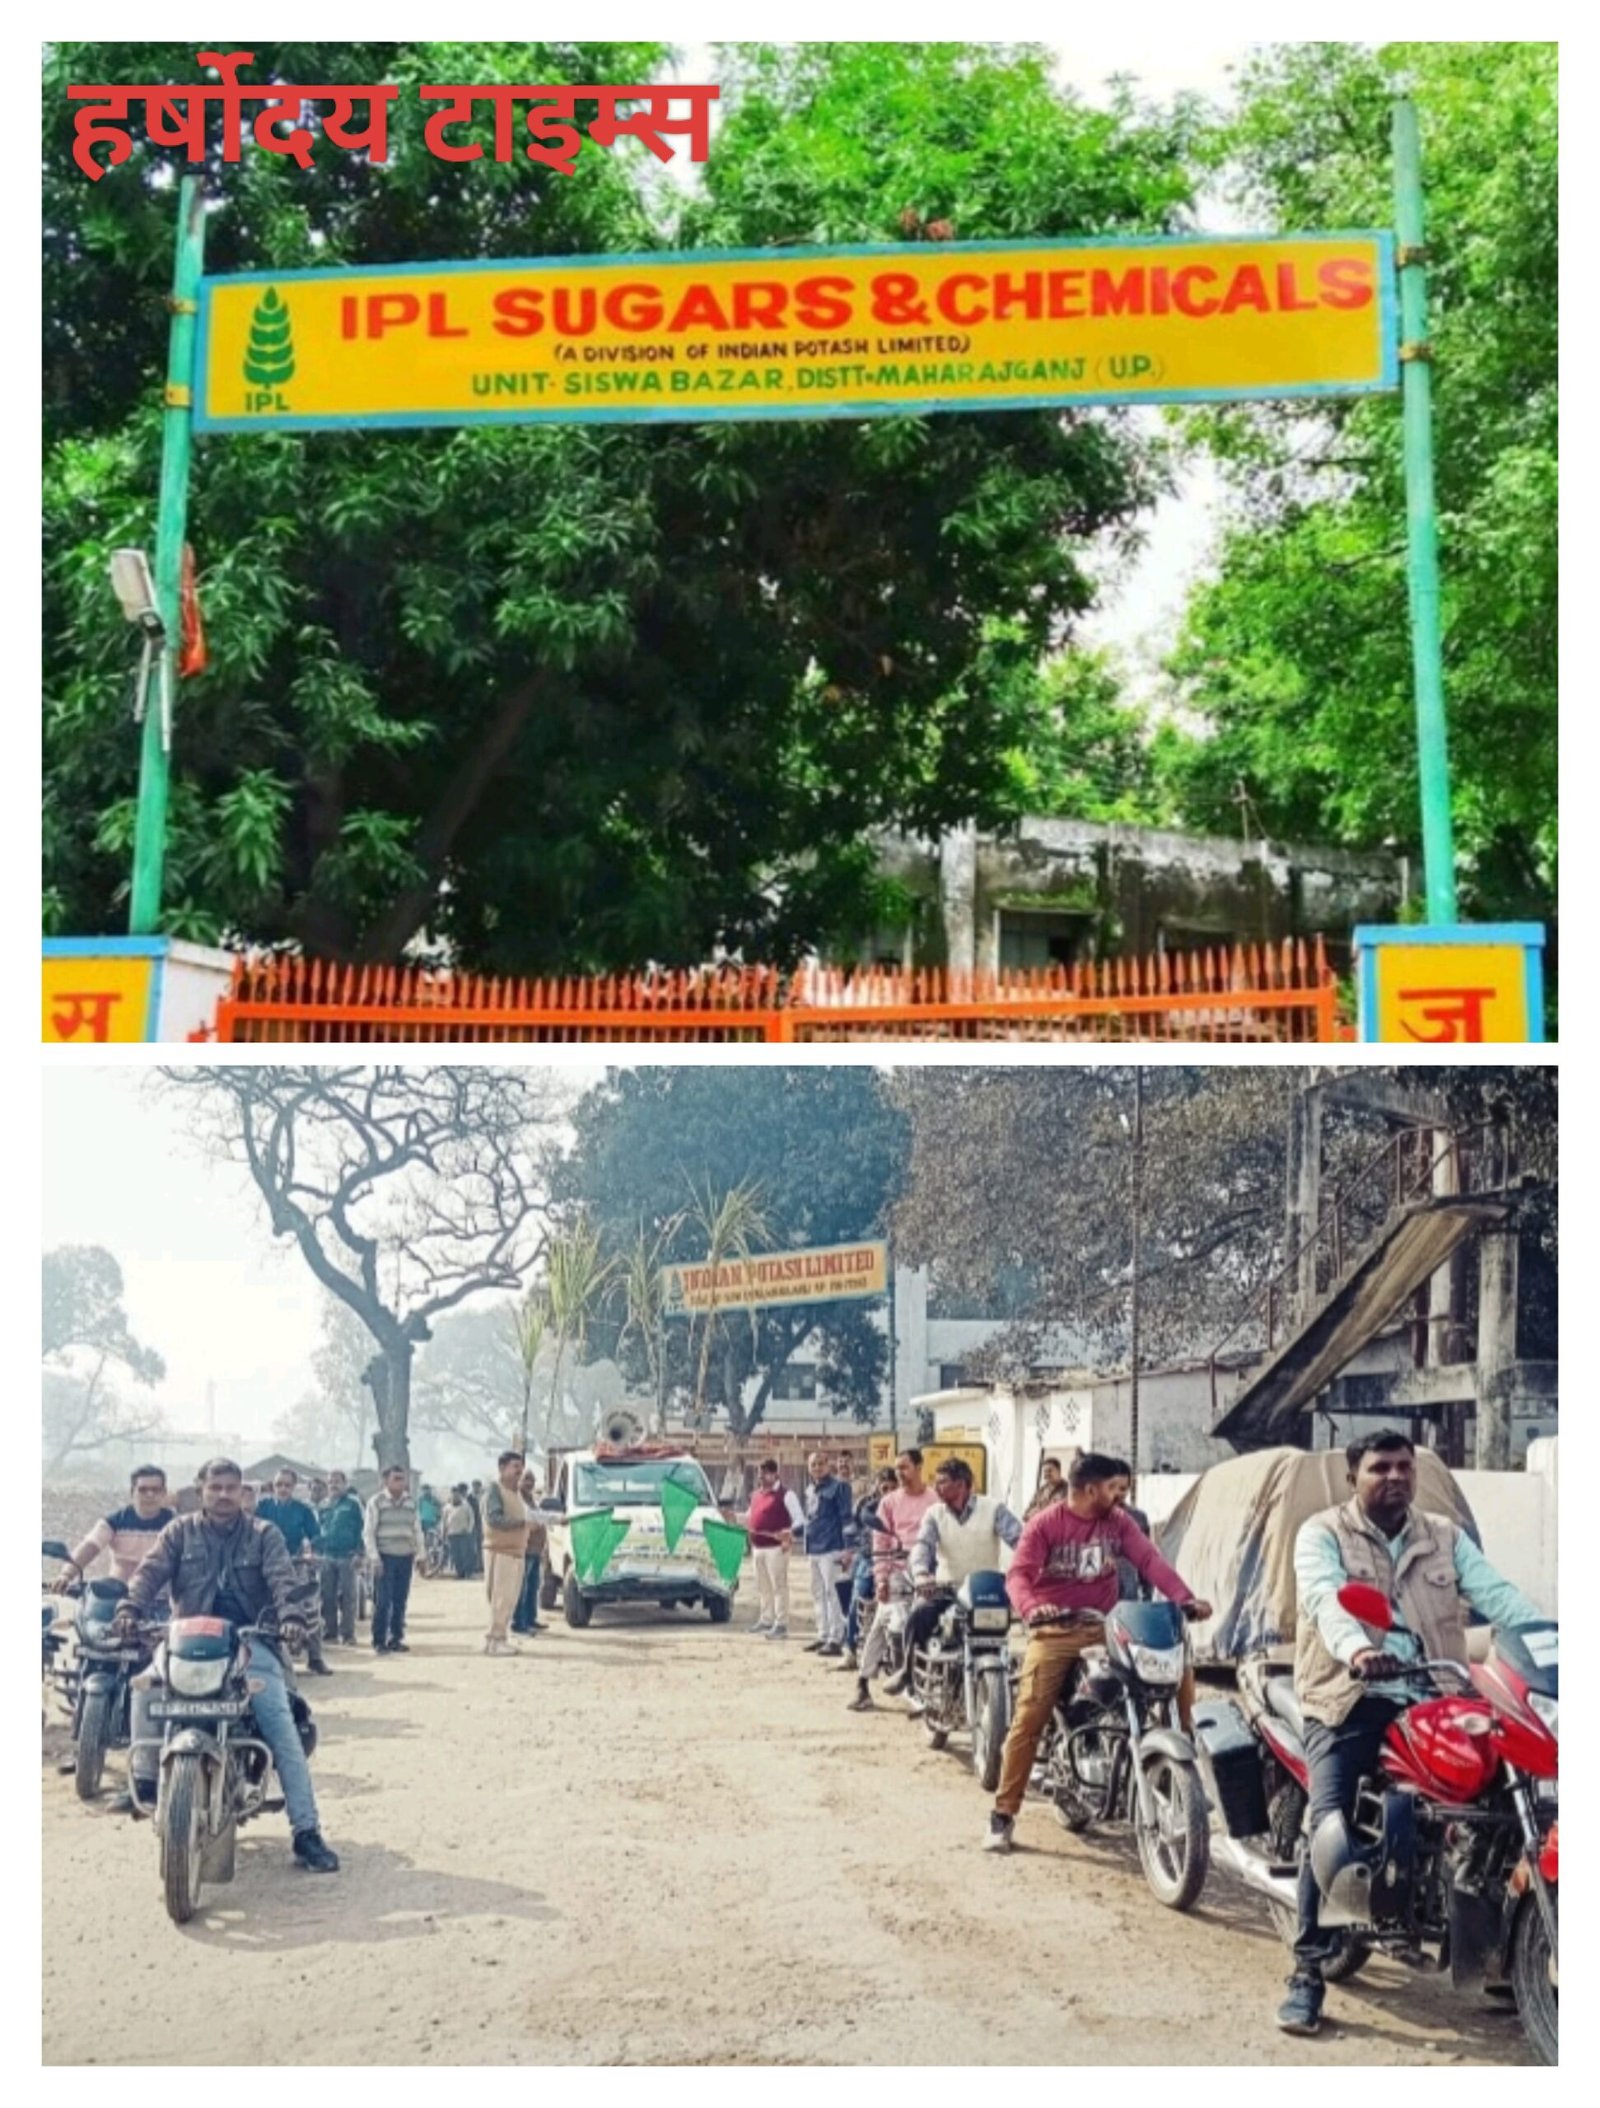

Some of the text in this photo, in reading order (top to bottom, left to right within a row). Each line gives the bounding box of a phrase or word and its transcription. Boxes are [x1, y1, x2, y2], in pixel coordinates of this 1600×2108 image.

[342, 293, 468, 340] IPL
[492, 279, 855, 337] SUGARS
[584, 344, 674, 362] DIVISION
[686, 343, 709, 359] OF
[718, 341, 787, 359] INDIAN
[795, 338, 868, 357] POTASH
[878, 335, 970, 354] LIMITED)
[564, 370, 662, 395] SISWA
[245, 391, 291, 412] IPL
[806, 1249, 875, 1279] LIMITED
